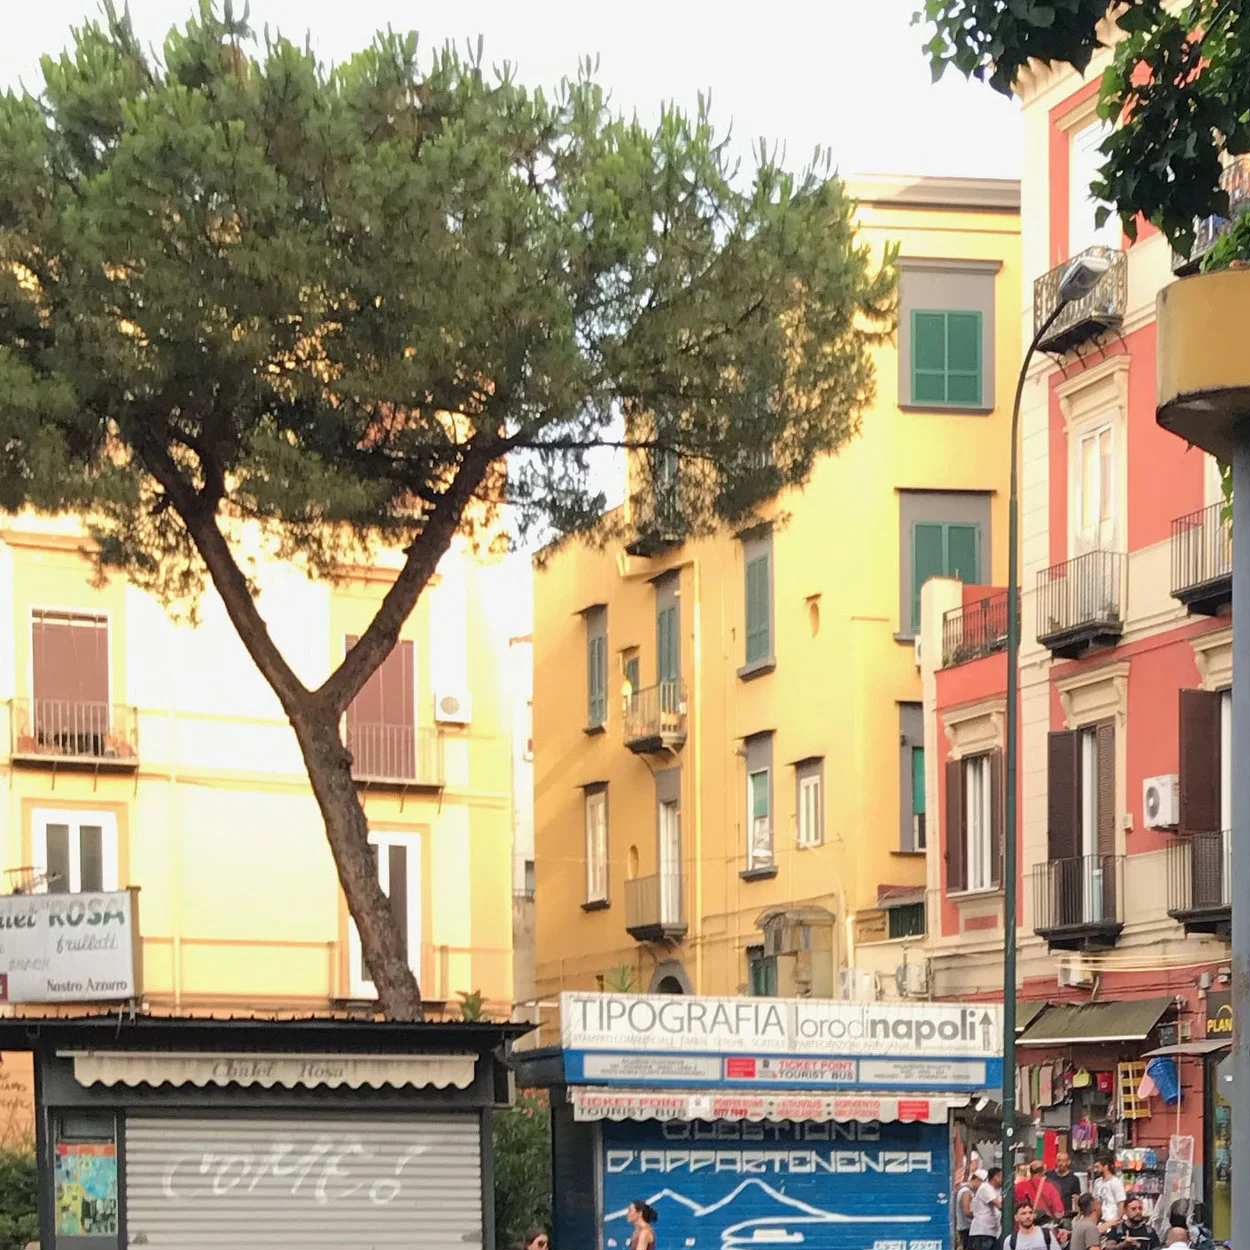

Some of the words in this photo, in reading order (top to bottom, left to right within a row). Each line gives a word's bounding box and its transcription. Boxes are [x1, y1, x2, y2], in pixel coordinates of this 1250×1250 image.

[573, 999, 785, 1037] TIPOGRAFIA
[779, 1060, 817, 1070] TICKET
[821, 1060, 853, 1071] POINT
[778, 1069, 825, 1080] TOURIST
[831, 1070, 853, 1080] BUS
[580, 1097, 634, 1107] TICKET
[639, 1097, 685, 1108] POINT
[580, 1107, 644, 1117] TOURIST
[655, 1107, 687, 1118] BUS
